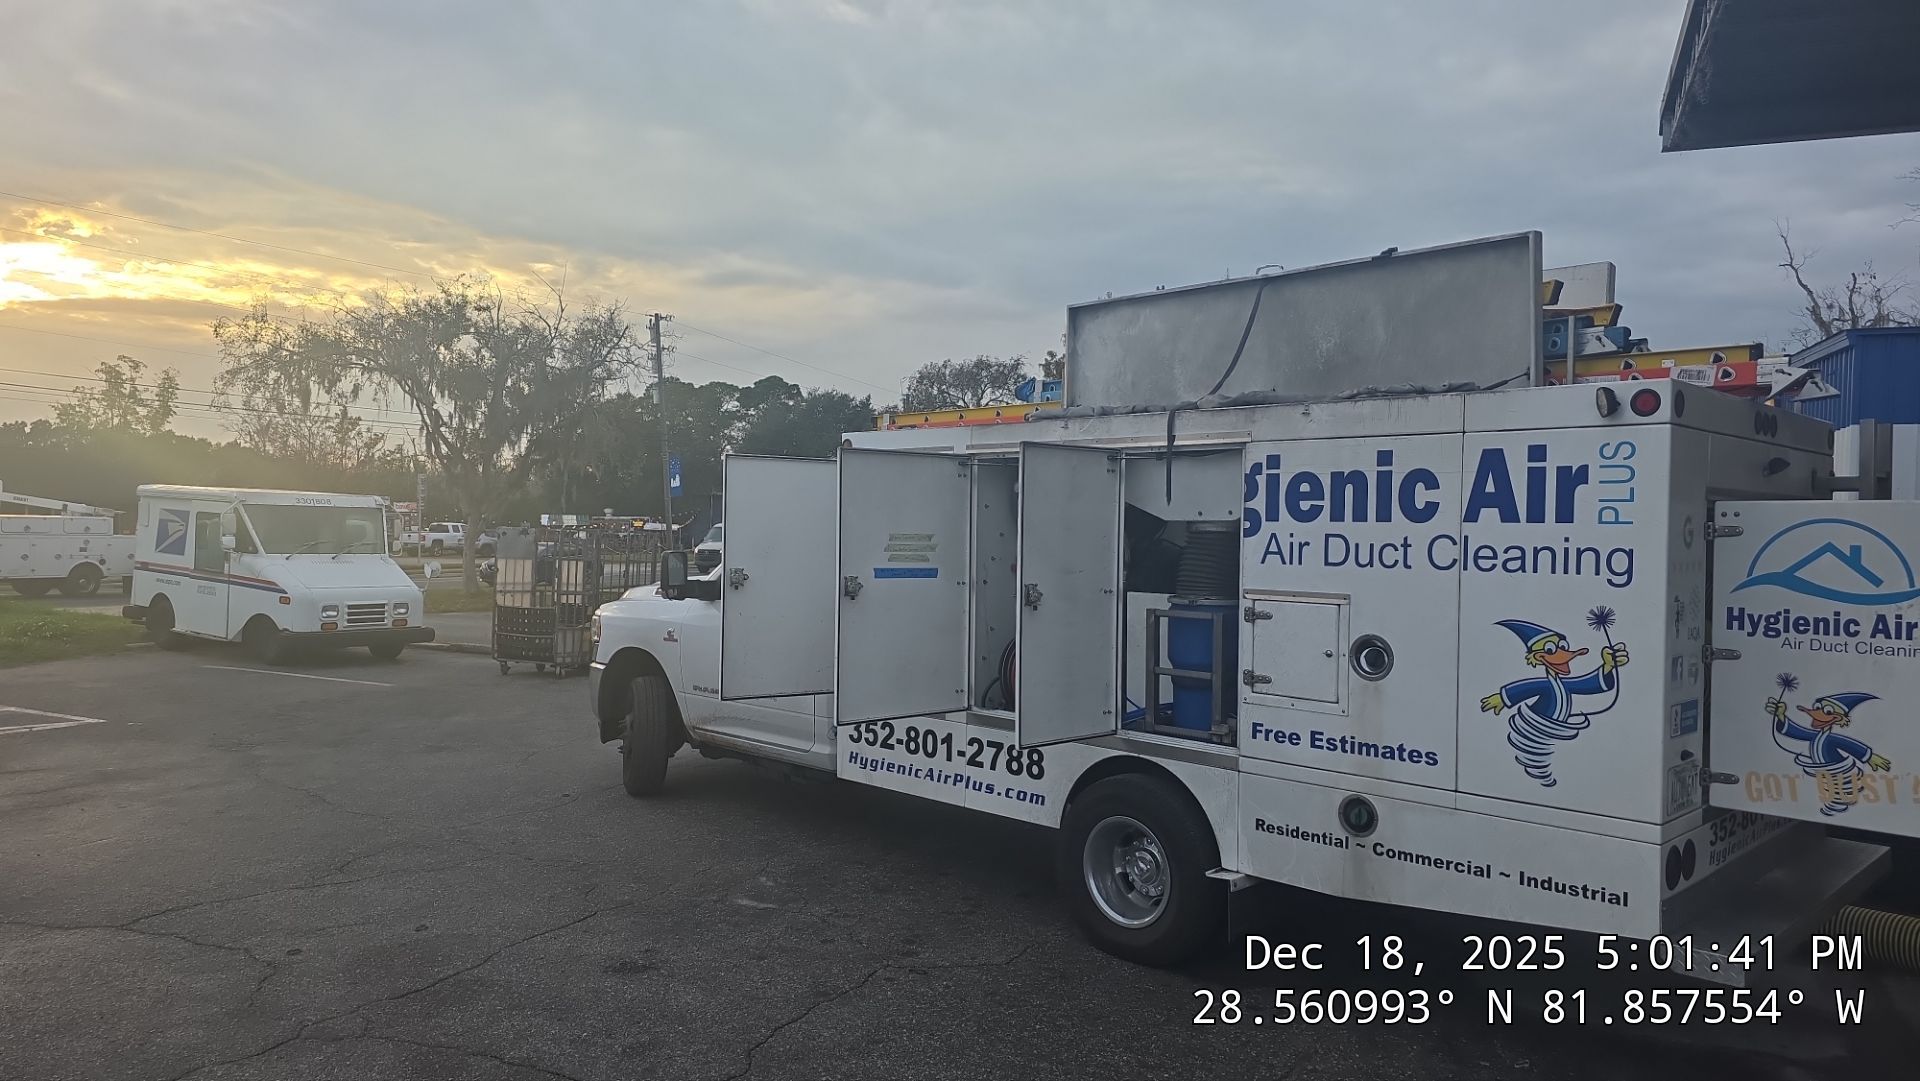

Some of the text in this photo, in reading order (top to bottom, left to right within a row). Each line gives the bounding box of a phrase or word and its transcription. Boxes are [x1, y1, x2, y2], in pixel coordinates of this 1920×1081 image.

[1463, 444, 1589, 523] Air
[1598, 441, 1636, 524] PLUS
[1260, 532, 1634, 588] Air Duct Cleaning
[1726, 607, 1918, 640] Hygienic Air
[1781, 637, 1804, 650] Air
[1809, 638, 1849, 654] Duct
[849, 721, 1045, 780] 352-801-2788
[1251, 722, 1439, 767] Free Estimates
[849, 751, 1046, 806] HygienicAirPlus.com
[1744, 770, 1800, 804] GOT
[1255, 817, 1350, 850] Residential
[1372, 842, 1491, 879] Commercial
[1519, 870, 1629, 907] Industrial
